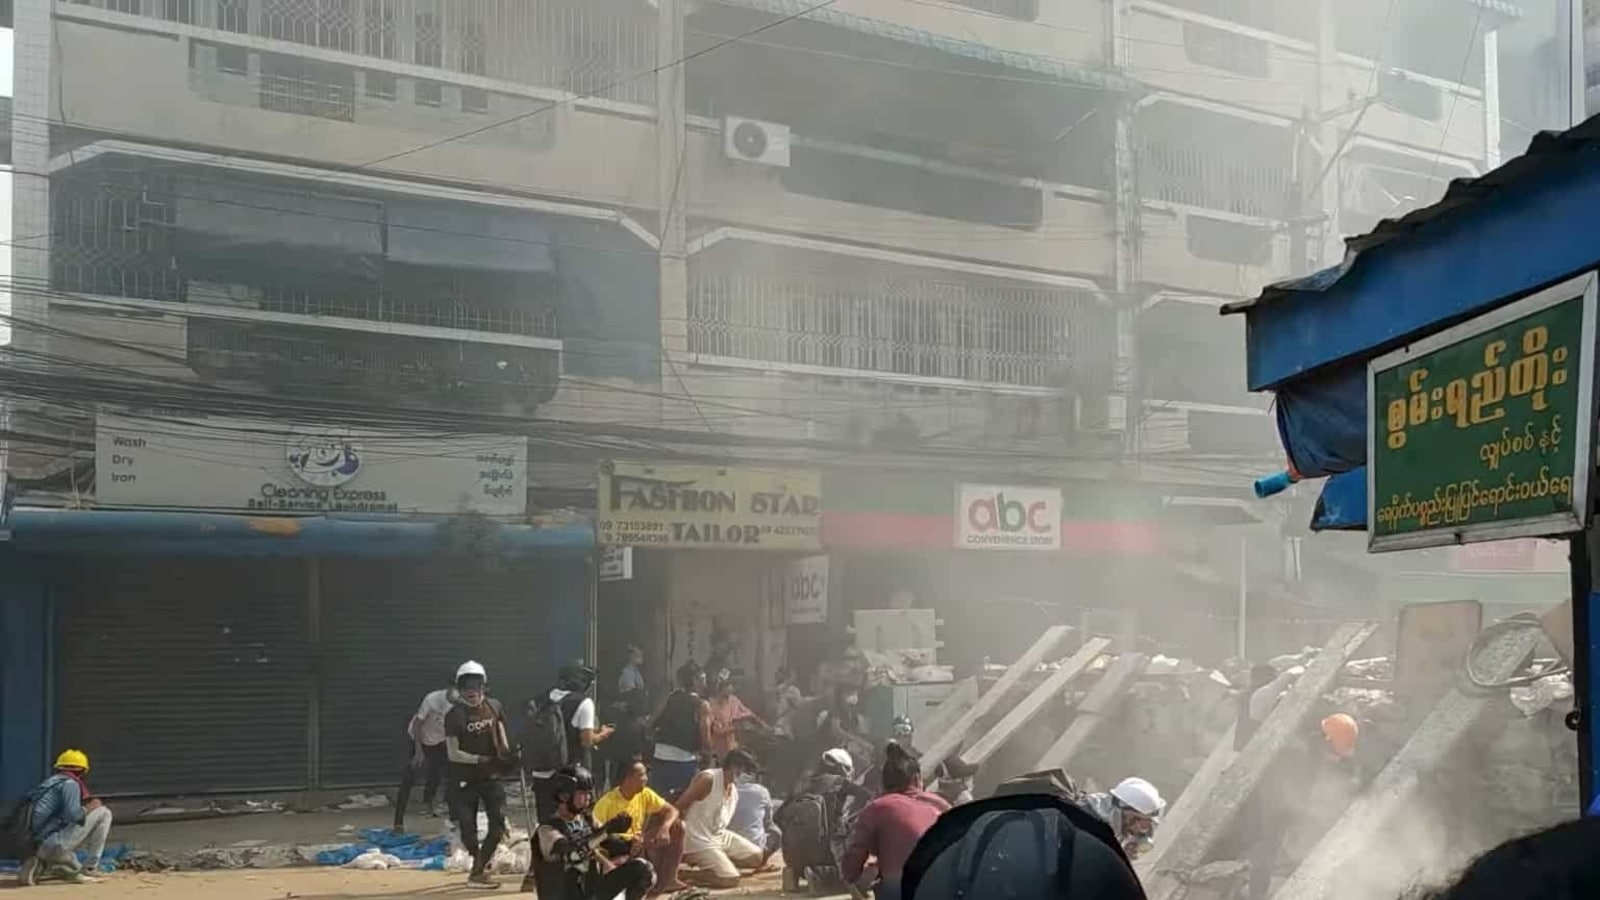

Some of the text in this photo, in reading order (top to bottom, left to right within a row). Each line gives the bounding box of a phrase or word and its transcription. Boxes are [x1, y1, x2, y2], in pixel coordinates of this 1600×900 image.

[112, 436, 147, 448] Wash
[111, 454, 134, 467] Dry
[111, 472, 137, 483] Iron
[261, 483, 387, 502] Cleaning Express
[248, 498, 322, 509] Self-Service
[751, 491, 818, 516] STAR
[968, 491, 1052, 533] abc
[671, 522, 760, 543] TAILOR
